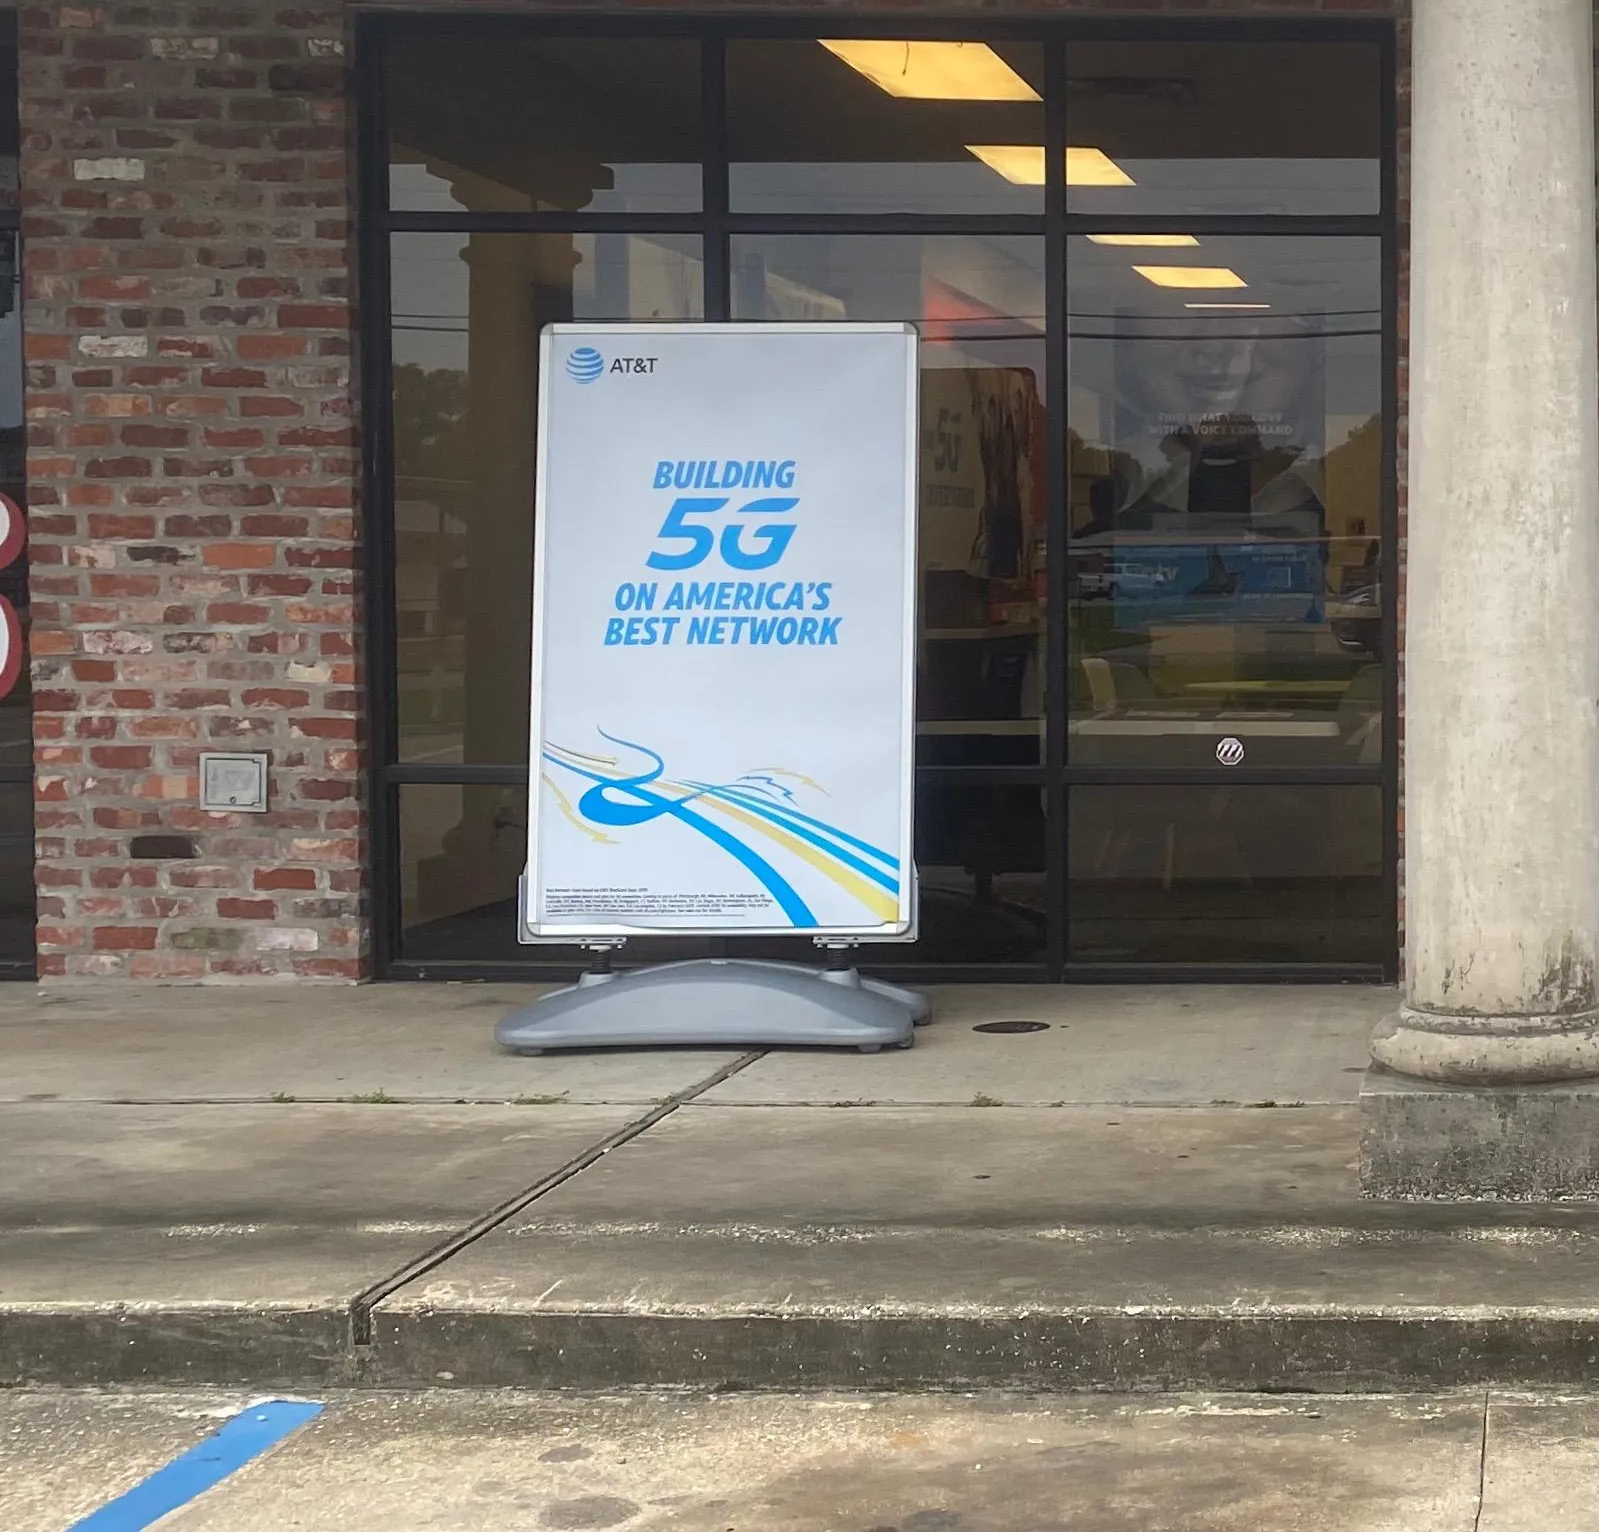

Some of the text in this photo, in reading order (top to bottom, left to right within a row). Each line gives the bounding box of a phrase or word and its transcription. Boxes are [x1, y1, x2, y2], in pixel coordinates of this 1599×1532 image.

[609, 357, 659, 374] AT&T
[653, 459, 796, 490] BUILDING
[645, 496, 800, 572] 5G
[613, 581, 832, 612] ON AMERICA'S
[603, 615, 844, 647] BEST NETWORK
